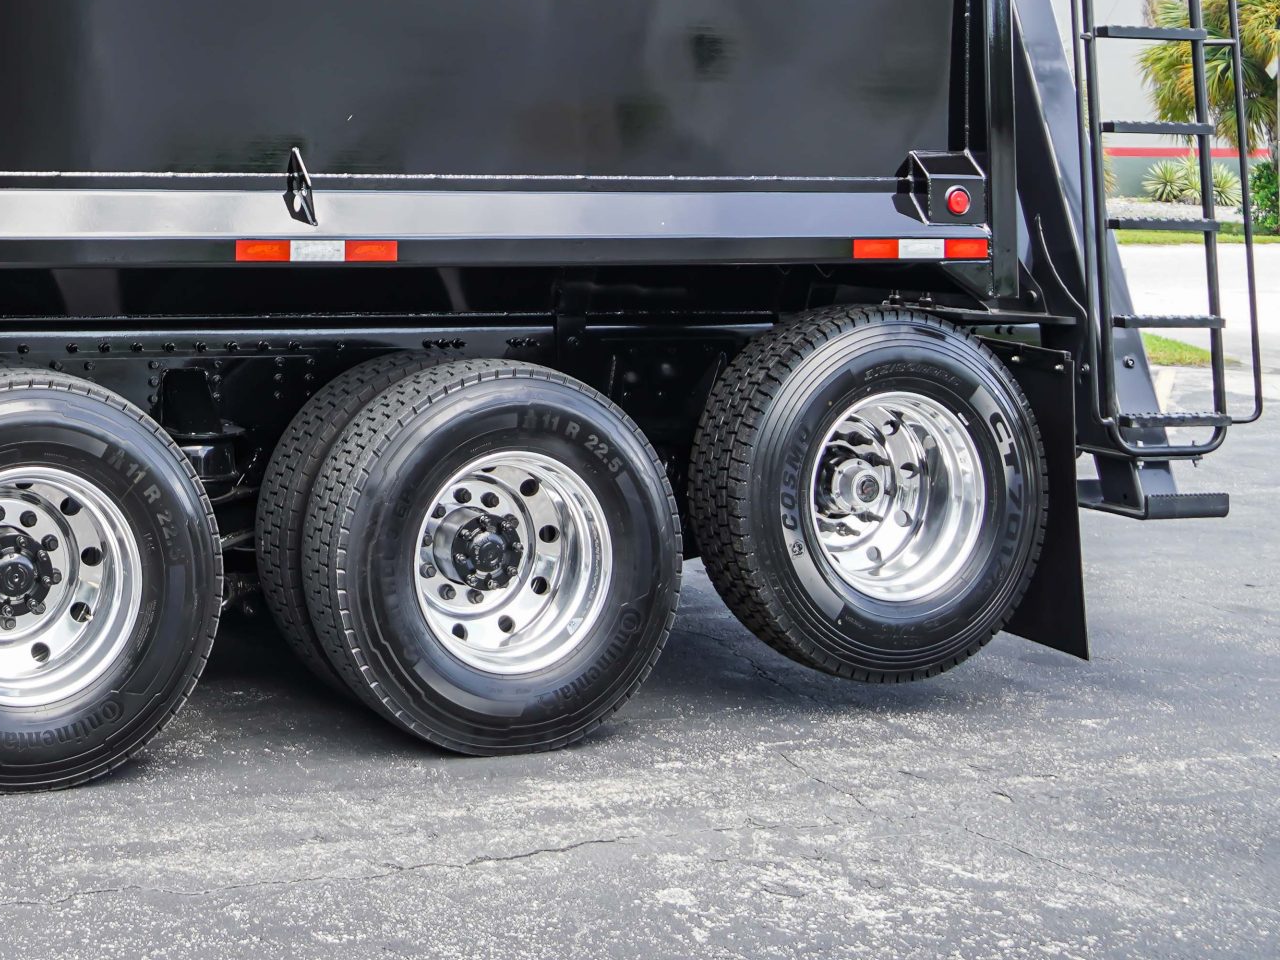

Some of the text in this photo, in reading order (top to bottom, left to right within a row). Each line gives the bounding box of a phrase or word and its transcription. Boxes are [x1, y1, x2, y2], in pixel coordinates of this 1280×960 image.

[565, 421, 581, 440] R
[584, 434, 623, 472] 22.5
[143, 483, 161, 504] R
[780, 421, 810, 531] COSMO
